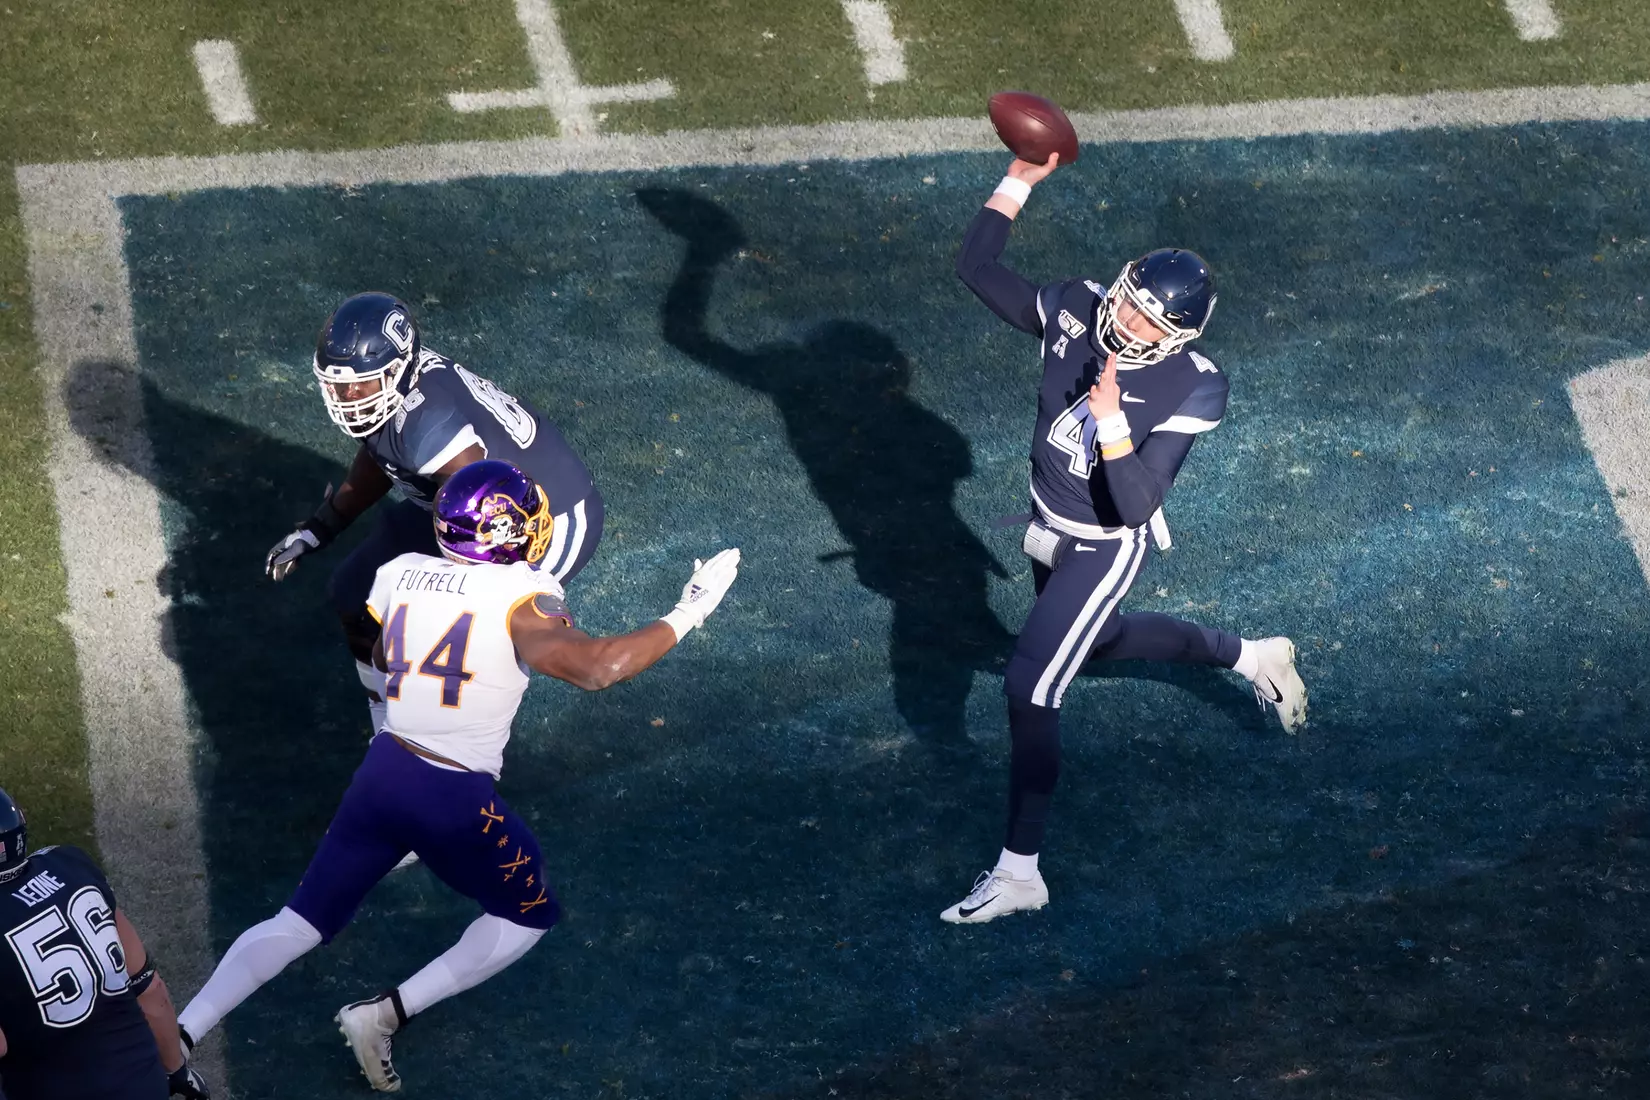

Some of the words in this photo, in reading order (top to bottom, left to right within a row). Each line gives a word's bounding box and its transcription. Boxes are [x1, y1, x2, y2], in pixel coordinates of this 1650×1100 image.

[382, 310, 415, 354] C
[1187, 351, 1219, 373] 4
[1046, 391, 1099, 480] 4
[489, 502, 507, 516] ECU
[397, 570, 467, 595] FUTRELL
[386, 603, 477, 709] 44
[12, 870, 66, 907] LEONE
[4, 885, 131, 1028] 56
